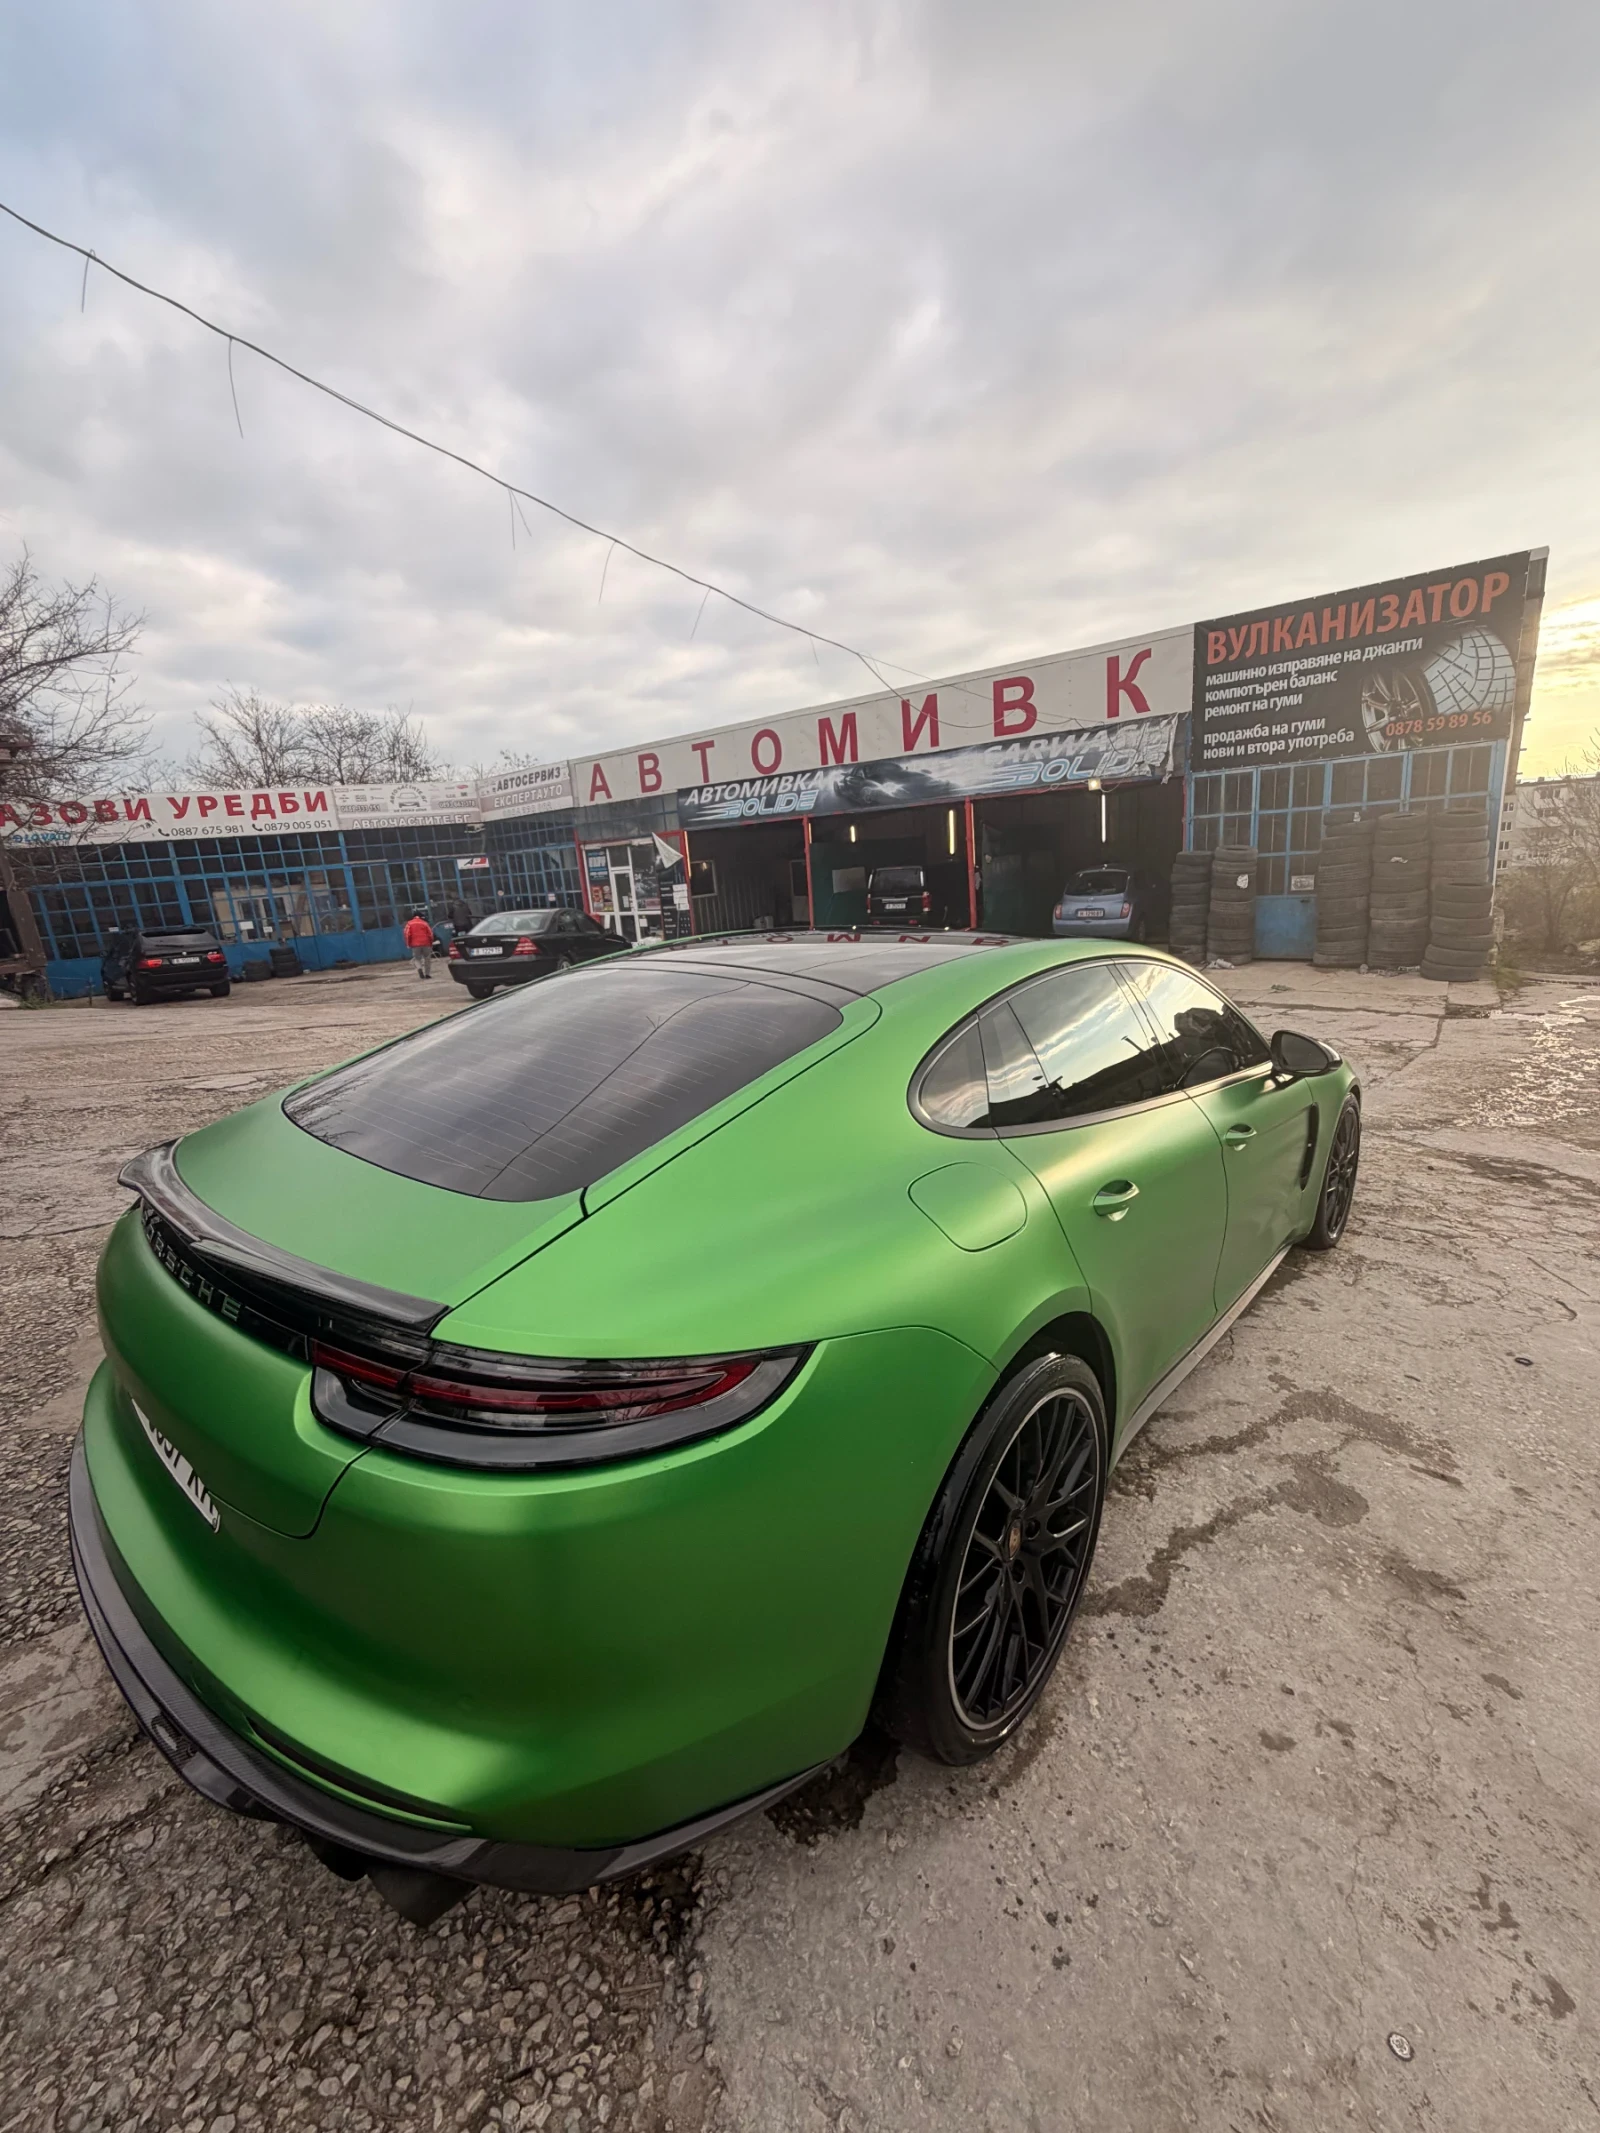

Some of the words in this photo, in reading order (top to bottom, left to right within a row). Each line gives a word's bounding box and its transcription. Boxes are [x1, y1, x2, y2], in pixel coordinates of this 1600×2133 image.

[1206, 571, 1509, 665] ВУЛКАНИЗАТОР
[1206, 666, 1267, 687] машинно
[1268, 651, 1342, 676] изправяне
[1343, 648, 1362, 662] на
[1362, 637, 1423, 662] джанти
[1205, 678, 1288, 703] компютърен
[1289, 669, 1339, 690] баланс
[1204, 701, 1251, 722] ремонт
[1252, 699, 1268, 712] на
[1270, 693, 1303, 712] гуми
[1203, 723, 1270, 747] продажба
[1271, 724, 1289, 737] на
[1291, 717, 1326, 736] гуми
[1386, 719, 1422, 736] 0878
[1426, 715, 1446, 732] 59
[1448, 713, 1469, 729] 89
[1472, 710, 1493, 726] 56
[1203, 745, 1235, 760] нови
[1236, 744, 1245, 756] и
[1247, 738, 1286, 756] втора
[1287, 727, 1355, 754] употреба
[497, 763, 561, 792] АВТОСЕРВИЗ
[684, 770, 825, 806] АВТОМИВКА
[0, 798, 152, 827] АЗОВИ
[166, 791, 328, 820] УРЕДБИ
[494, 785, 563, 808] ЕКСПЕРТАУТО
[714, 789, 819, 820] BOLIDE
[171, 827, 198, 837] 0887
[202, 825, 223, 835] 675
[225, 824, 245, 834] 981
[264, 822, 290, 832] 0879
[292, 820, 312, 830] 005
[314, 819, 333, 829] 051
[352, 814, 470, 830] АВТОЧАСТИТЕ.БГ
